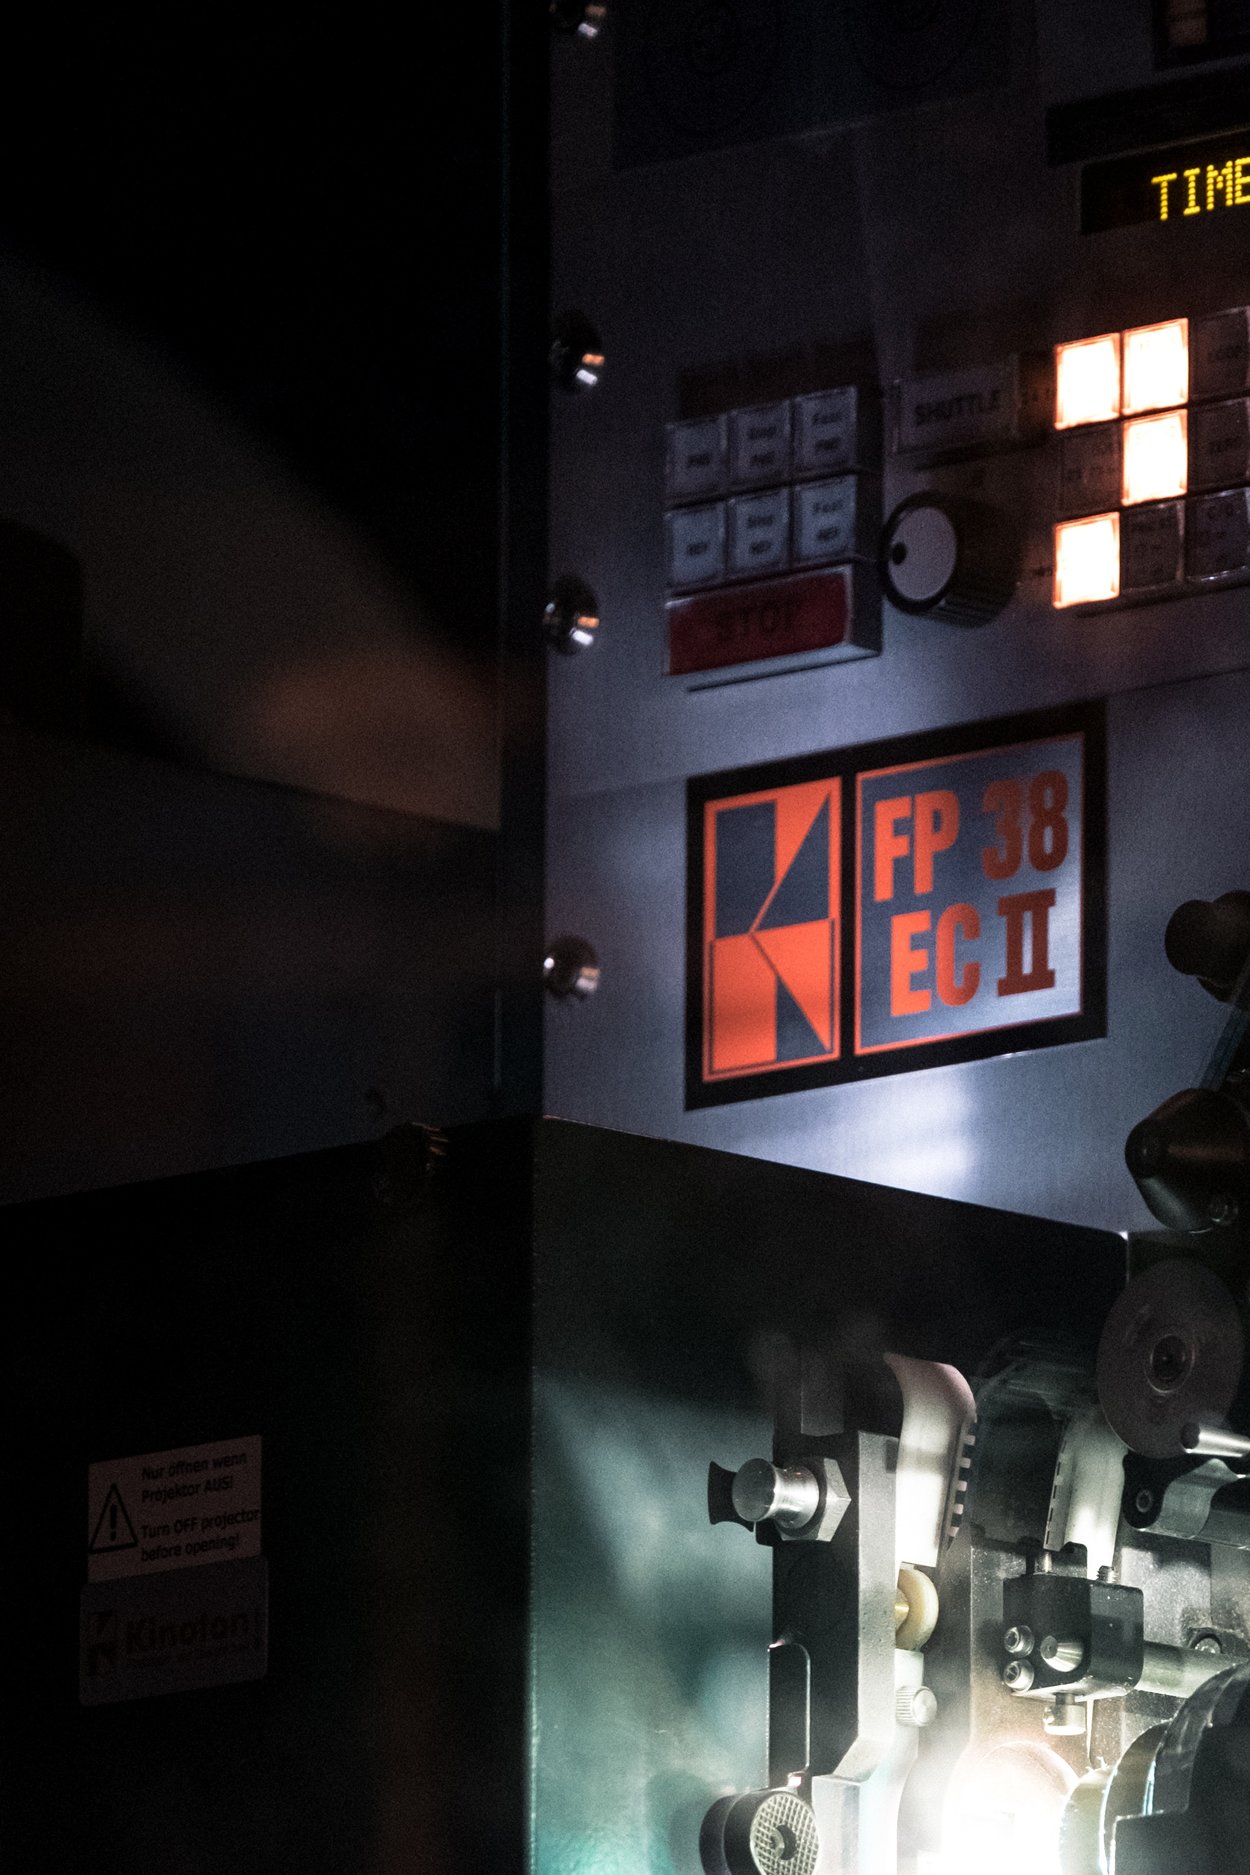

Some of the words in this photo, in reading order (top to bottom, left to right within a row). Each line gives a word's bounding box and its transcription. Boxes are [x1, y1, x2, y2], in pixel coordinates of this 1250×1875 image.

[914, 389, 1001, 426] SHUTTLE
[716, 599, 804, 642] STOP
[873, 788, 961, 904] FP
[981, 769, 1070, 883] 38
[890, 902, 982, 1018] EC
[996, 887, 1057, 998] II
[142, 1467, 165, 1481] Nur
[168, 1459, 209, 1478] öffnen
[212, 1453, 248, 1470] wenn
[142, 1482, 201, 1505] Projektor
[204, 1475, 234, 1495] AUS!
[141, 1523, 171, 1540] Turn
[174, 1517, 198, 1534] OFF
[201, 1508, 261, 1532] projector
[141, 1544, 182, 1562] before
[185, 1532, 240, 1557] opening!
